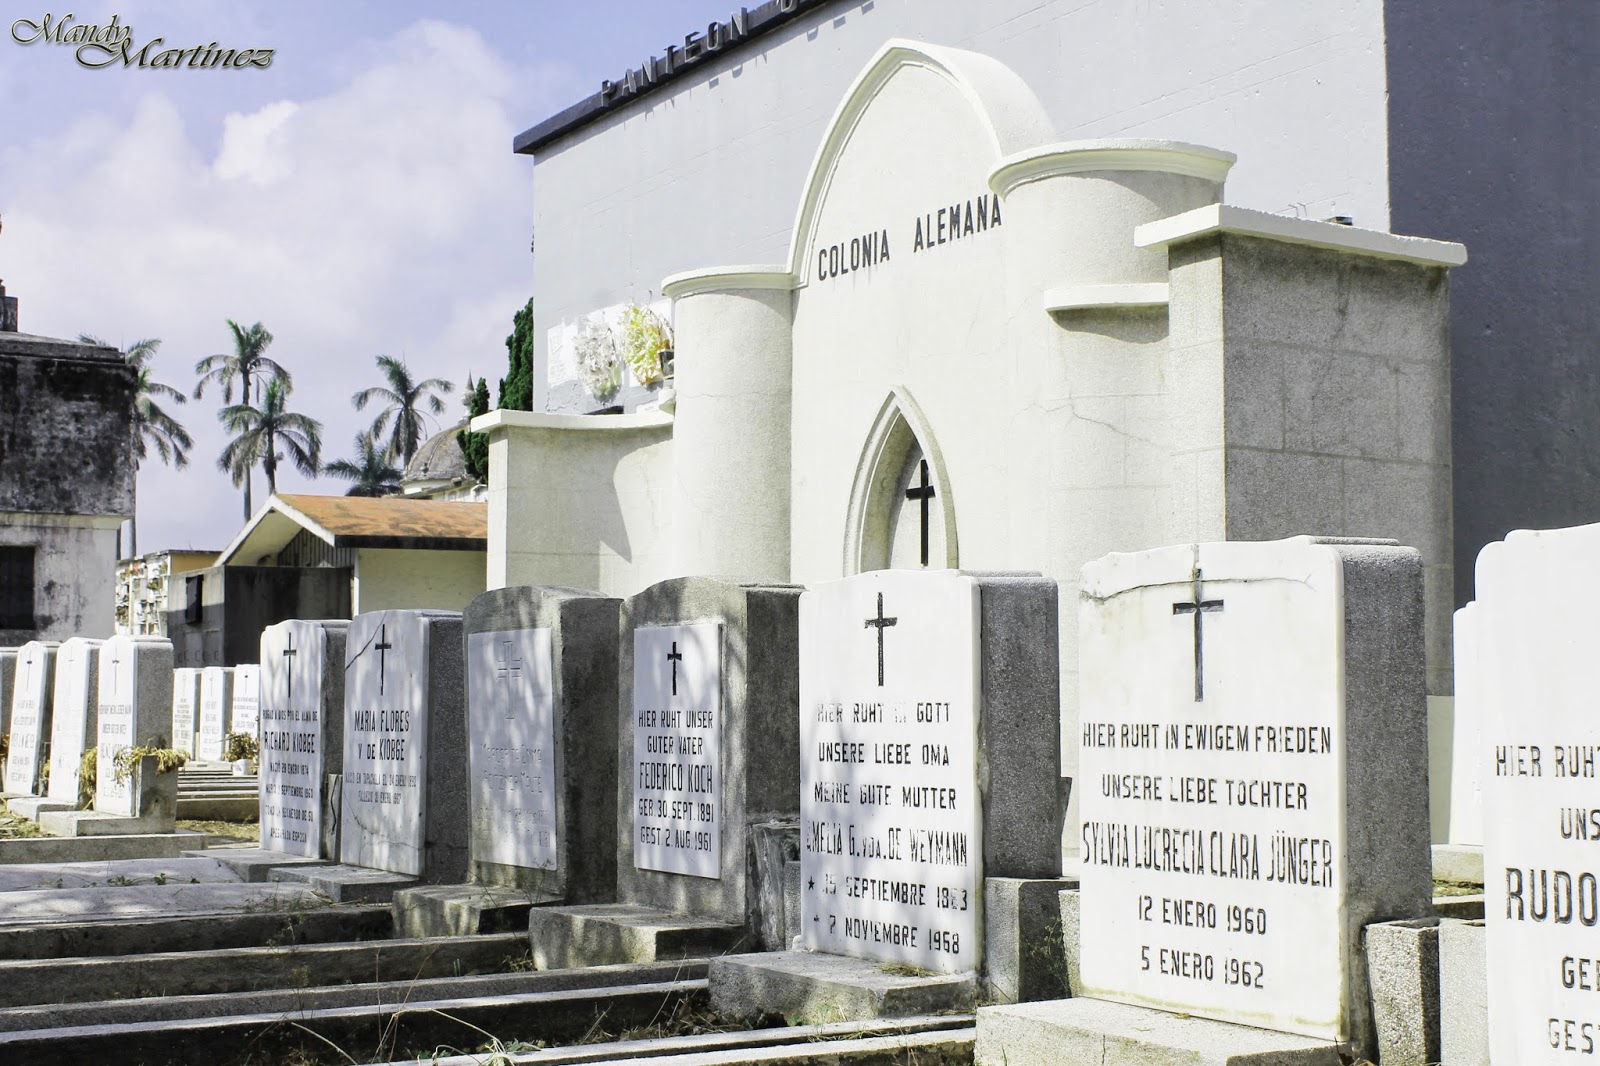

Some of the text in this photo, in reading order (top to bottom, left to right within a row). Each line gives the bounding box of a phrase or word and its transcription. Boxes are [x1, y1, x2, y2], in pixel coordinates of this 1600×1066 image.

[600, 6, 748, 108] PANTEON
[818, 193, 1002, 281] COLONIA ALEMANA
[354, 710, 410, 732] MARIA FLORES
[638, 710, 713, 729] HIER RUHT UNSER
[853, 702, 884, 723] RUHT
[917, 702, 951, 723] GOTT
[264, 731, 290, 752] RICHARD
[366, 744, 376, 759] DE
[647, 736, 702, 755] GUTER VATER
[818, 742, 950, 766] UNSERE LIEBE OMA
[1083, 722, 1331, 754] HIER RUHT IN EWIGEM FRIEDEN
[1496, 745, 1600, 778] HIER RUH
[639, 762, 713, 794] FEDERICO KOCH
[1102, 774, 1307, 810] UNSERE LIEBE TOCHTER
[814, 782, 956, 810] MEINE GUTE MUTTER
[909, 829, 968, 867] WEYMANN
[1083, 821, 1332, 888] SYLVIA LUCRECIA CLARA JÜNGER
[846, 876, 926, 906] SEPTIEMBRE
[1505, 866, 1598, 927] RUDO
[1138, 895, 1267, 935] 12 ENERO 1960
[845, 916, 918, 948] NOVIEMBRE
[929, 928, 960, 954] 1968
[1141, 945, 1264, 989] 5 ENERO 1962
[1548, 1017, 1600, 1055] GES
